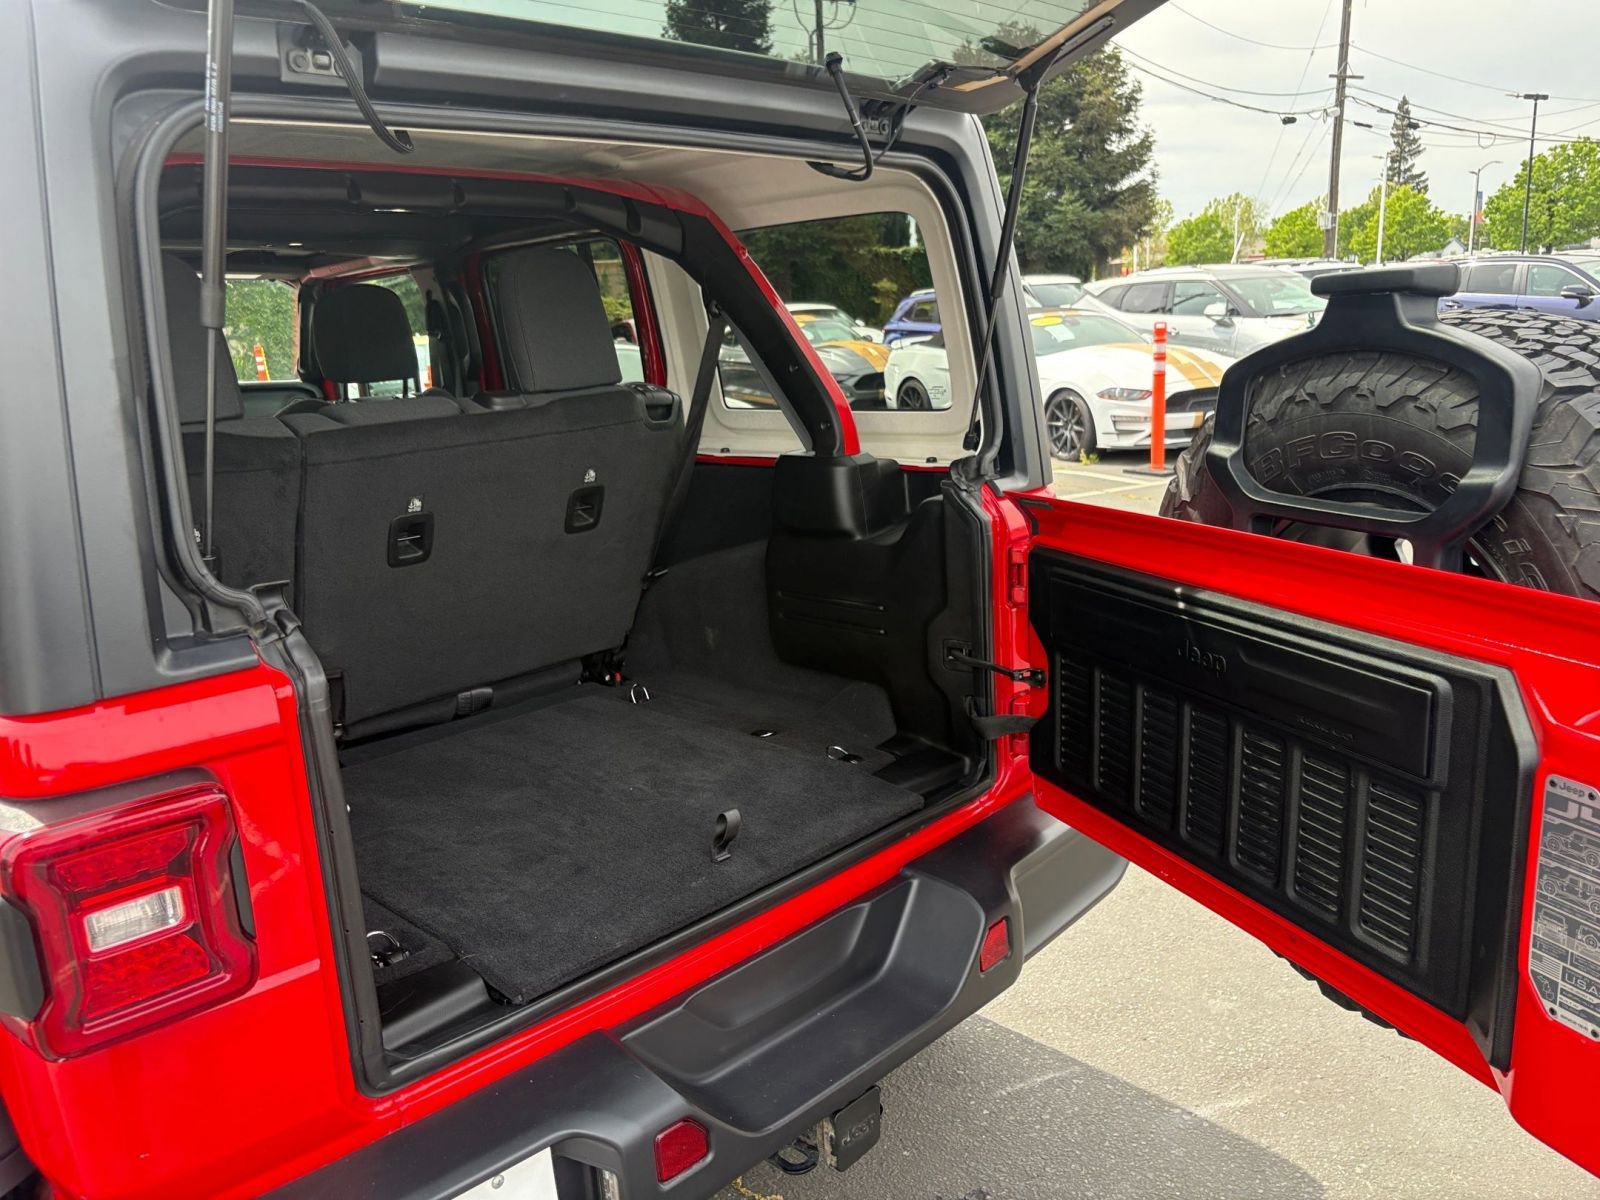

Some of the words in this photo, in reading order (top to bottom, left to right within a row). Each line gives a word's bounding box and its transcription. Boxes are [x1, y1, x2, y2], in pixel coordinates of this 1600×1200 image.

[1176, 639, 1227, 679] Jeep
[1559, 782, 1586, 798] Jeep
[841, 1112, 876, 1147] Jeep
